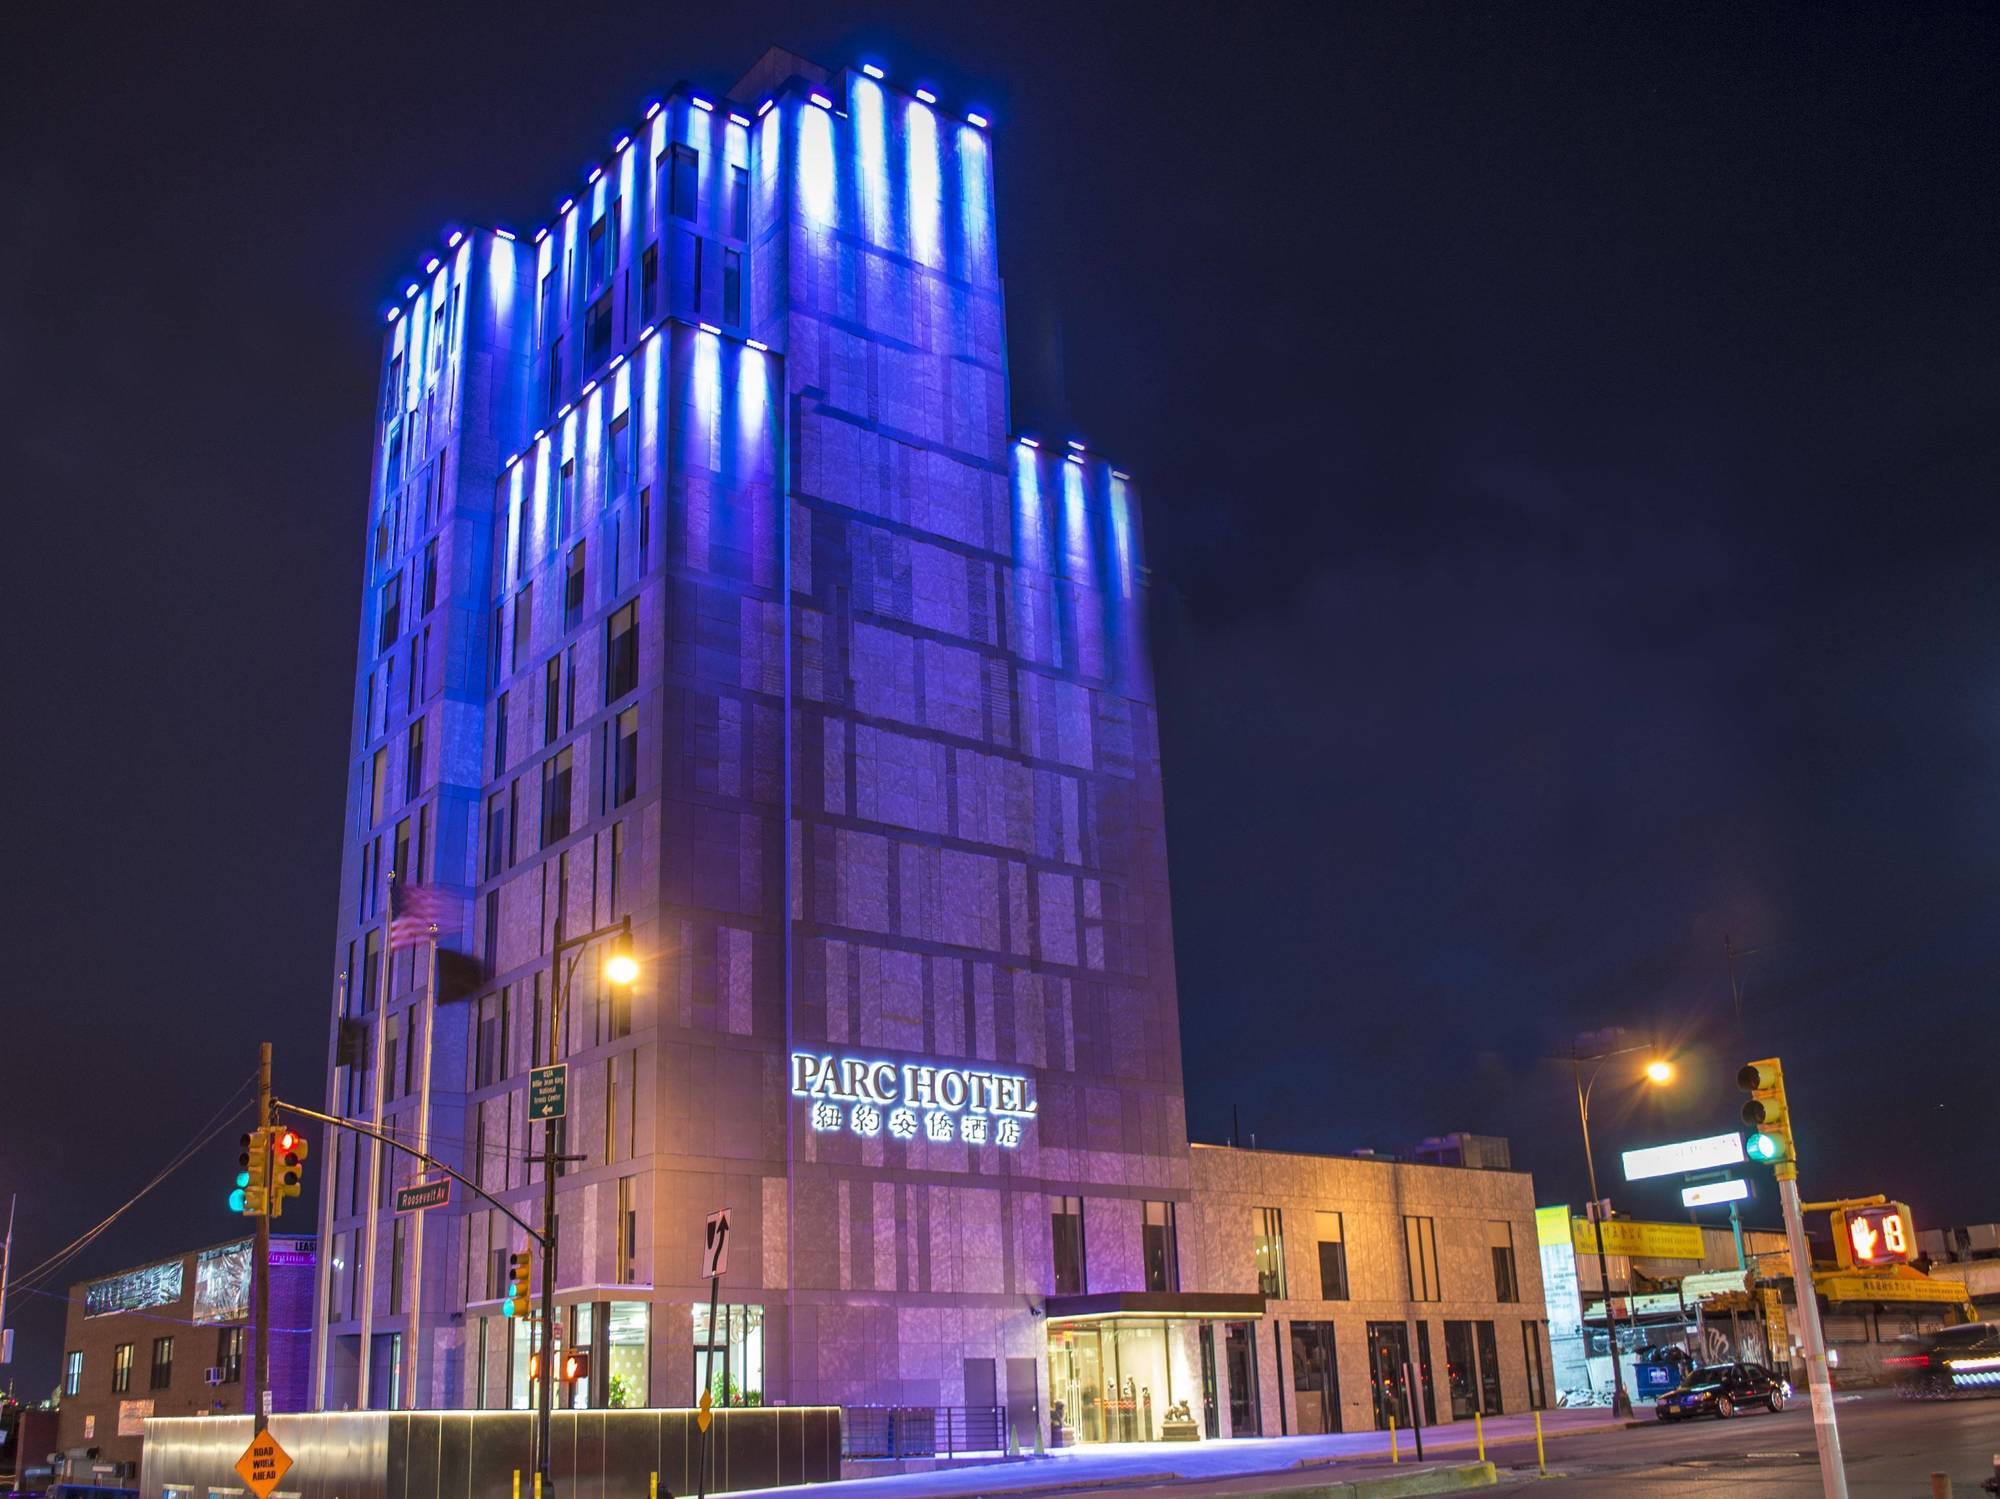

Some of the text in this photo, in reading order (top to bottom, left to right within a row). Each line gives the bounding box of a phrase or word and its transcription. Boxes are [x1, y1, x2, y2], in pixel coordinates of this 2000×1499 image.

[791, 1053, 1038, 1116] PARC HOTEL
[812, 1101, 1022, 1147] 紐約安僑酒店
[402, 1188, 436, 1207] Roosevelt
[295, 1241, 316, 1251] LEAS
[254, 1447, 273, 1456] ROAD
[253, 1459, 274, 1469] WORK
[253, 1471, 275, 1480] AHEAD
